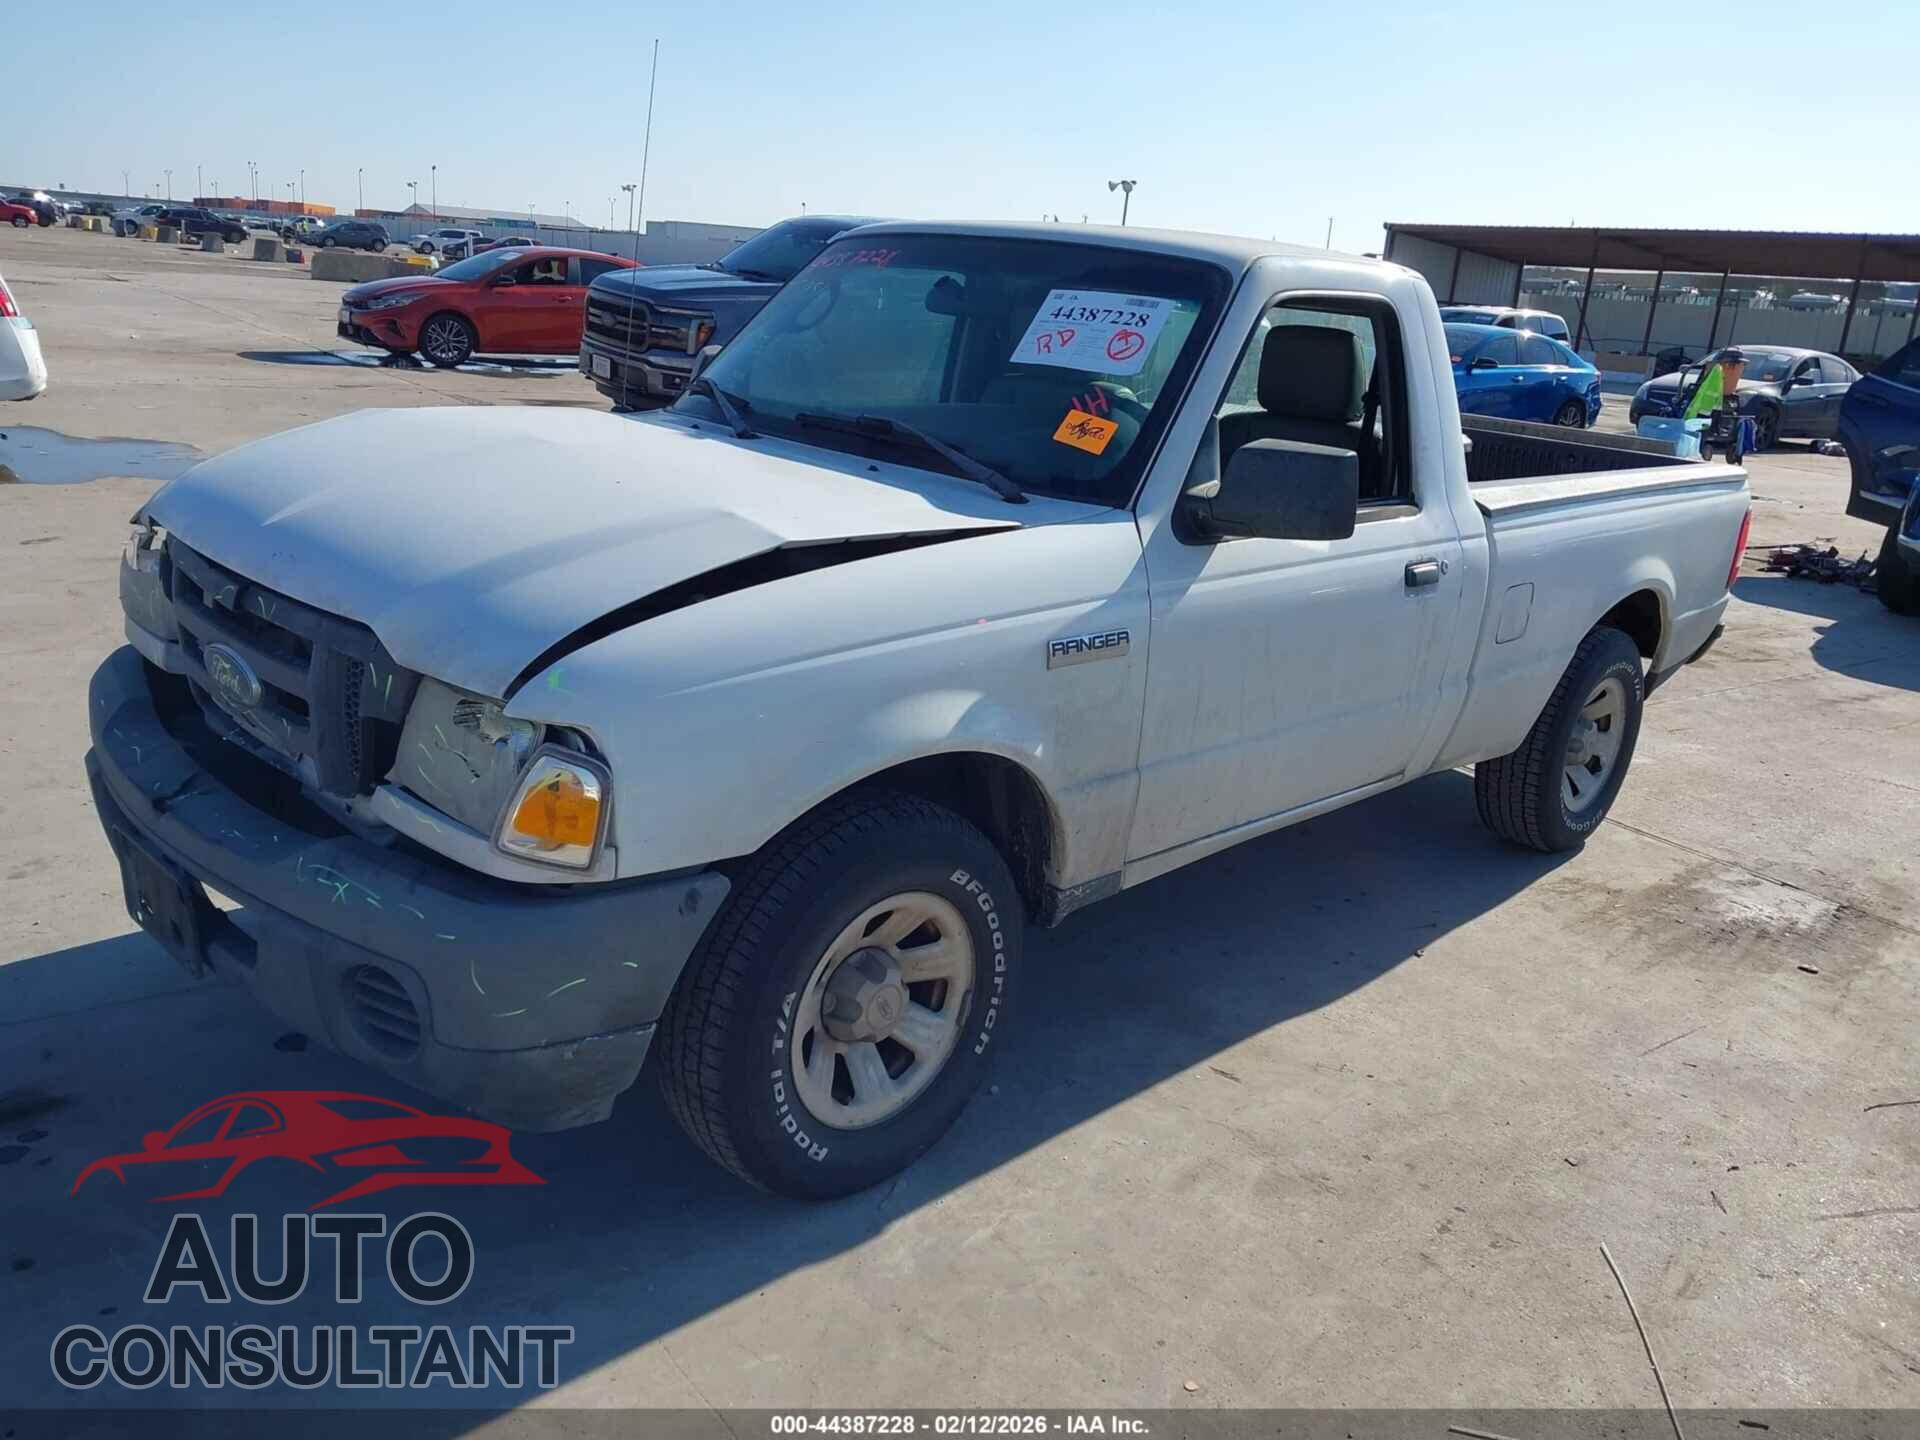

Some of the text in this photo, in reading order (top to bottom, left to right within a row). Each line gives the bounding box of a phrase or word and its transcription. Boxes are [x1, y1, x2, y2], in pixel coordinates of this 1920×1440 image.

[1050, 306, 1150, 328] 44387228
[1051, 631, 1129, 657] RANGER
[950, 869, 1006, 1054] BFGoodrich
[771, 992, 828, 1162] Radial T/A
